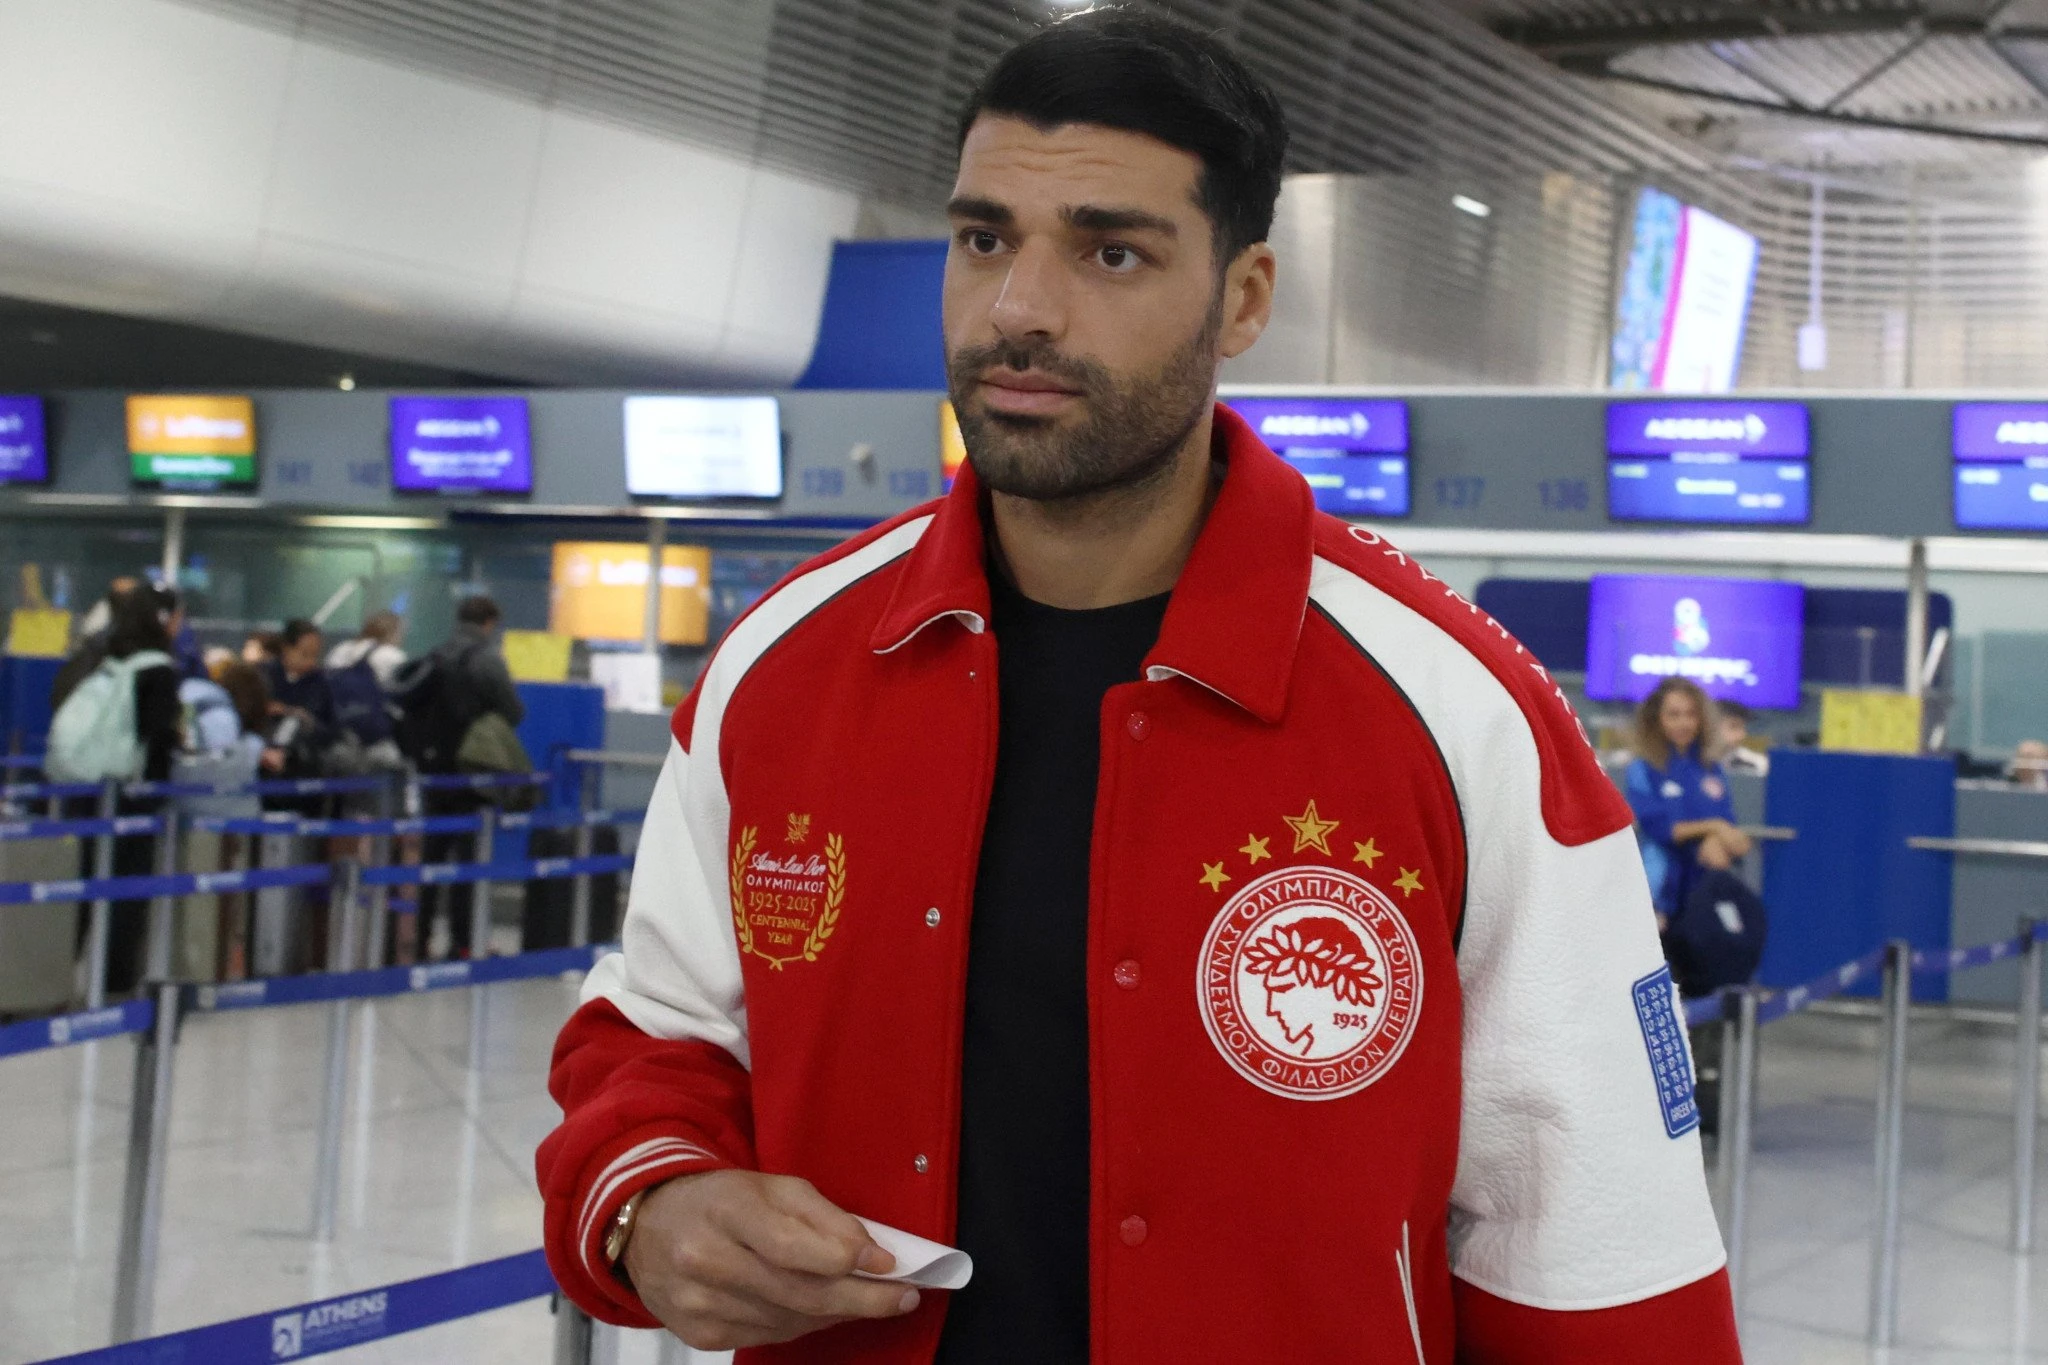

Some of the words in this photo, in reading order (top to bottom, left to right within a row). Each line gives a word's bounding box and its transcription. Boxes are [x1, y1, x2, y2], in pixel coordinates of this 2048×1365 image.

[1435, 474, 1485, 508] 137
[1240, 879, 1387, 929] ΟΛΥΜΠΙΑΚΟΣ
[768, 931, 793, 945] YEAR
[1332, 1012, 1368, 1029] 1925
[304, 1291, 388, 1330] ATHENS
